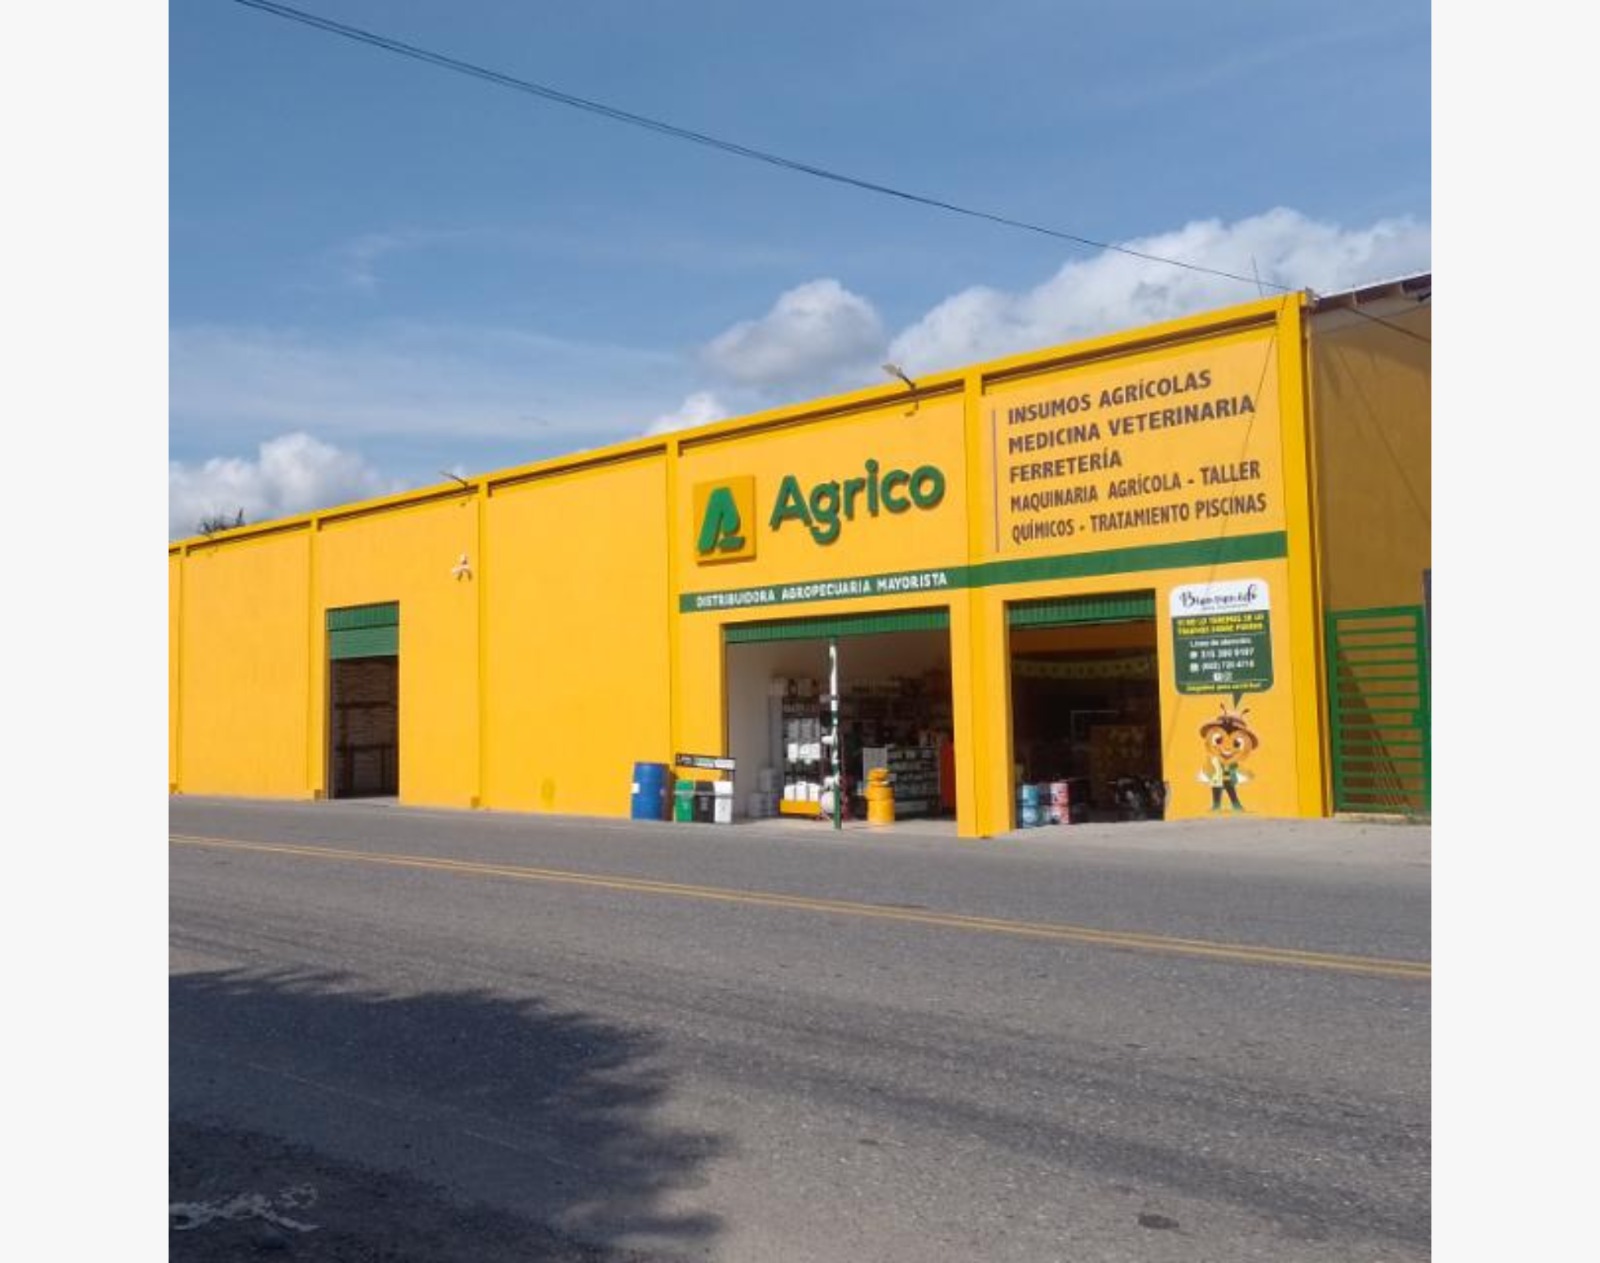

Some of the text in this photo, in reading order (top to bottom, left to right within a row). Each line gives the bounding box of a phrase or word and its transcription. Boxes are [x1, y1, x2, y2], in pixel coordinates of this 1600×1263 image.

[1008, 369, 1211, 425] INSUMOS AGRÍCOLAS
[1009, 395, 1255, 454] MEDICINA VETERINARIA
[1010, 449, 1122, 483] FERRETERÍA
[1010, 485, 1098, 513] MAQUINARIA
[1108, 472, 1181, 499] AGRÍCOLA
[1200, 461, 1260, 486] TALLER
[770, 459, 946, 545] Agrico
[1012, 518, 1075, 544] QUÍMICOS
[1090, 502, 1189, 533] TRATAMIENTO
[1195, 493, 1266, 519] PISCINAS
[696, 571, 947, 608] DISTRIBUIDORA AGROPECUARIA MAYORISTA
